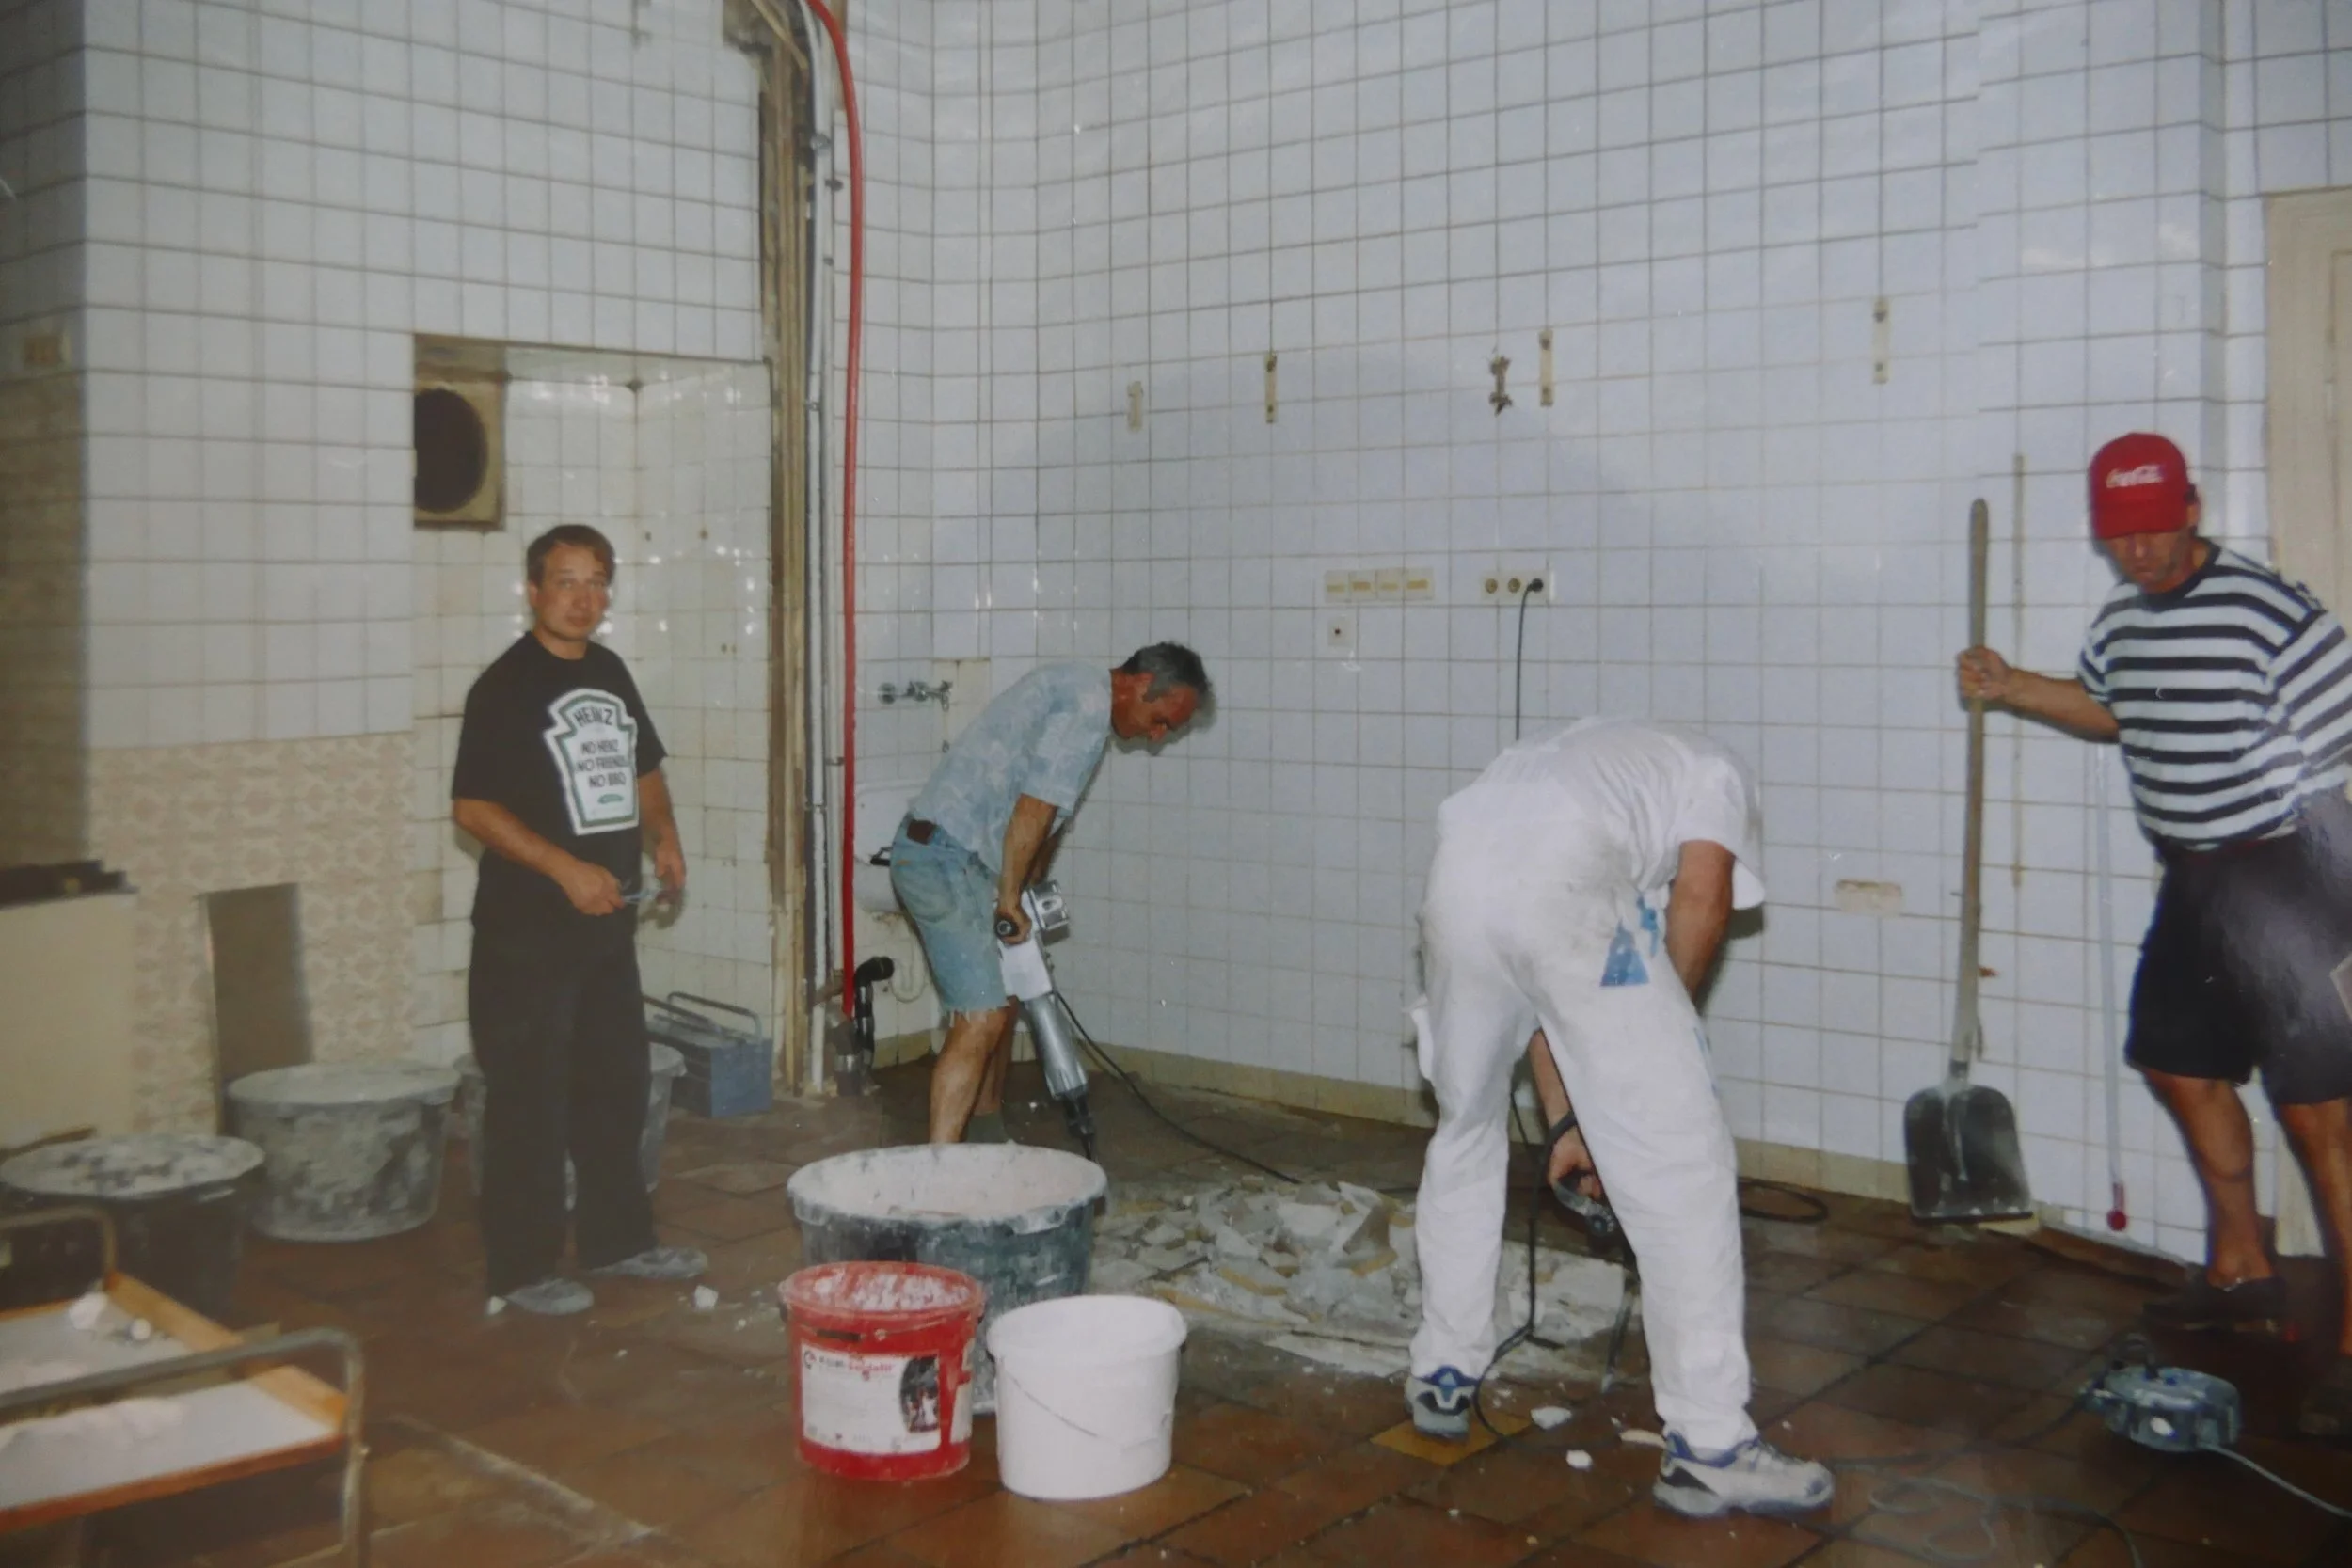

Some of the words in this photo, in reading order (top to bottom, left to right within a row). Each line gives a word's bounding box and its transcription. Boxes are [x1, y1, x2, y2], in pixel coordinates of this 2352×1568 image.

[574, 707, 613, 727] HEINZ
[580, 741, 596, 755] NO
[576, 759, 594, 773] NO
[588, 775, 605, 788] NO
